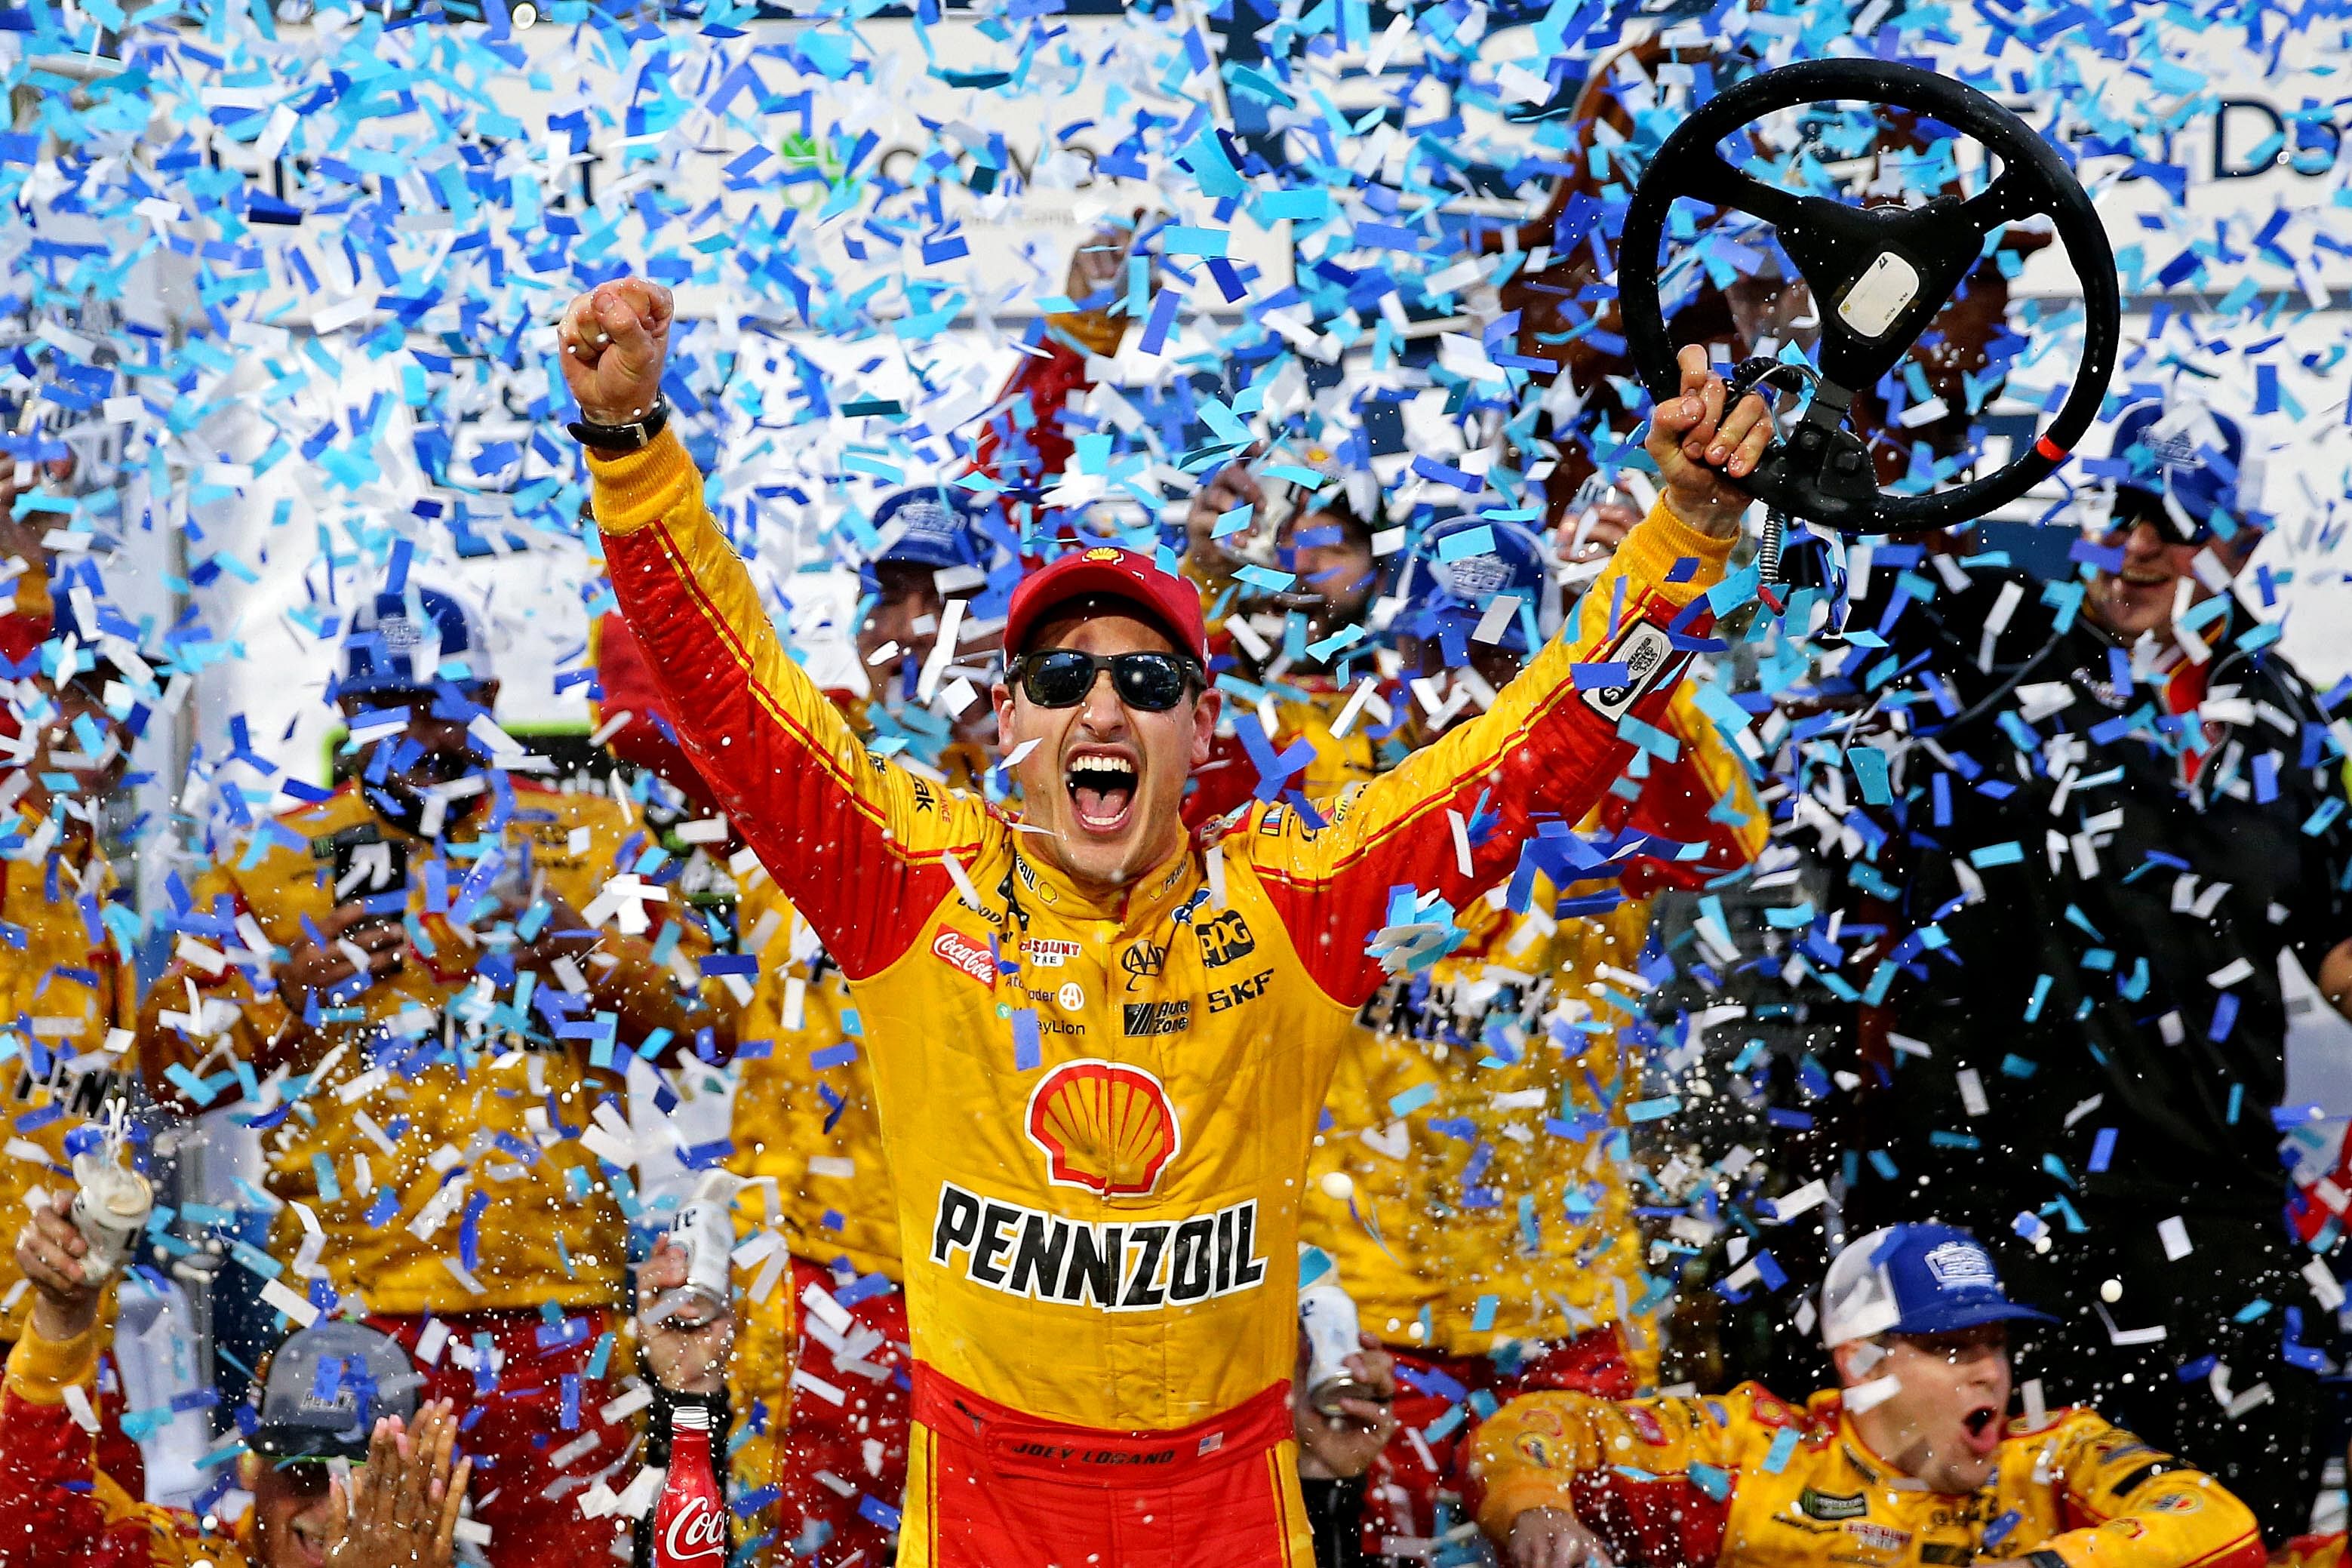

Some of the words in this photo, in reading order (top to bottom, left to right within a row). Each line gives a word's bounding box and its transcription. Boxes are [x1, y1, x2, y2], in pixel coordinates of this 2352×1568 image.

[1199, 917, 1252, 963] PPG
[1207, 968, 1274, 1013] SKF
[931, 1183, 1265, 1310] PENNZOIL
[1013, 1443, 1075, 1459] JOEY
[1081, 1450, 1176, 1465] LOGANO
